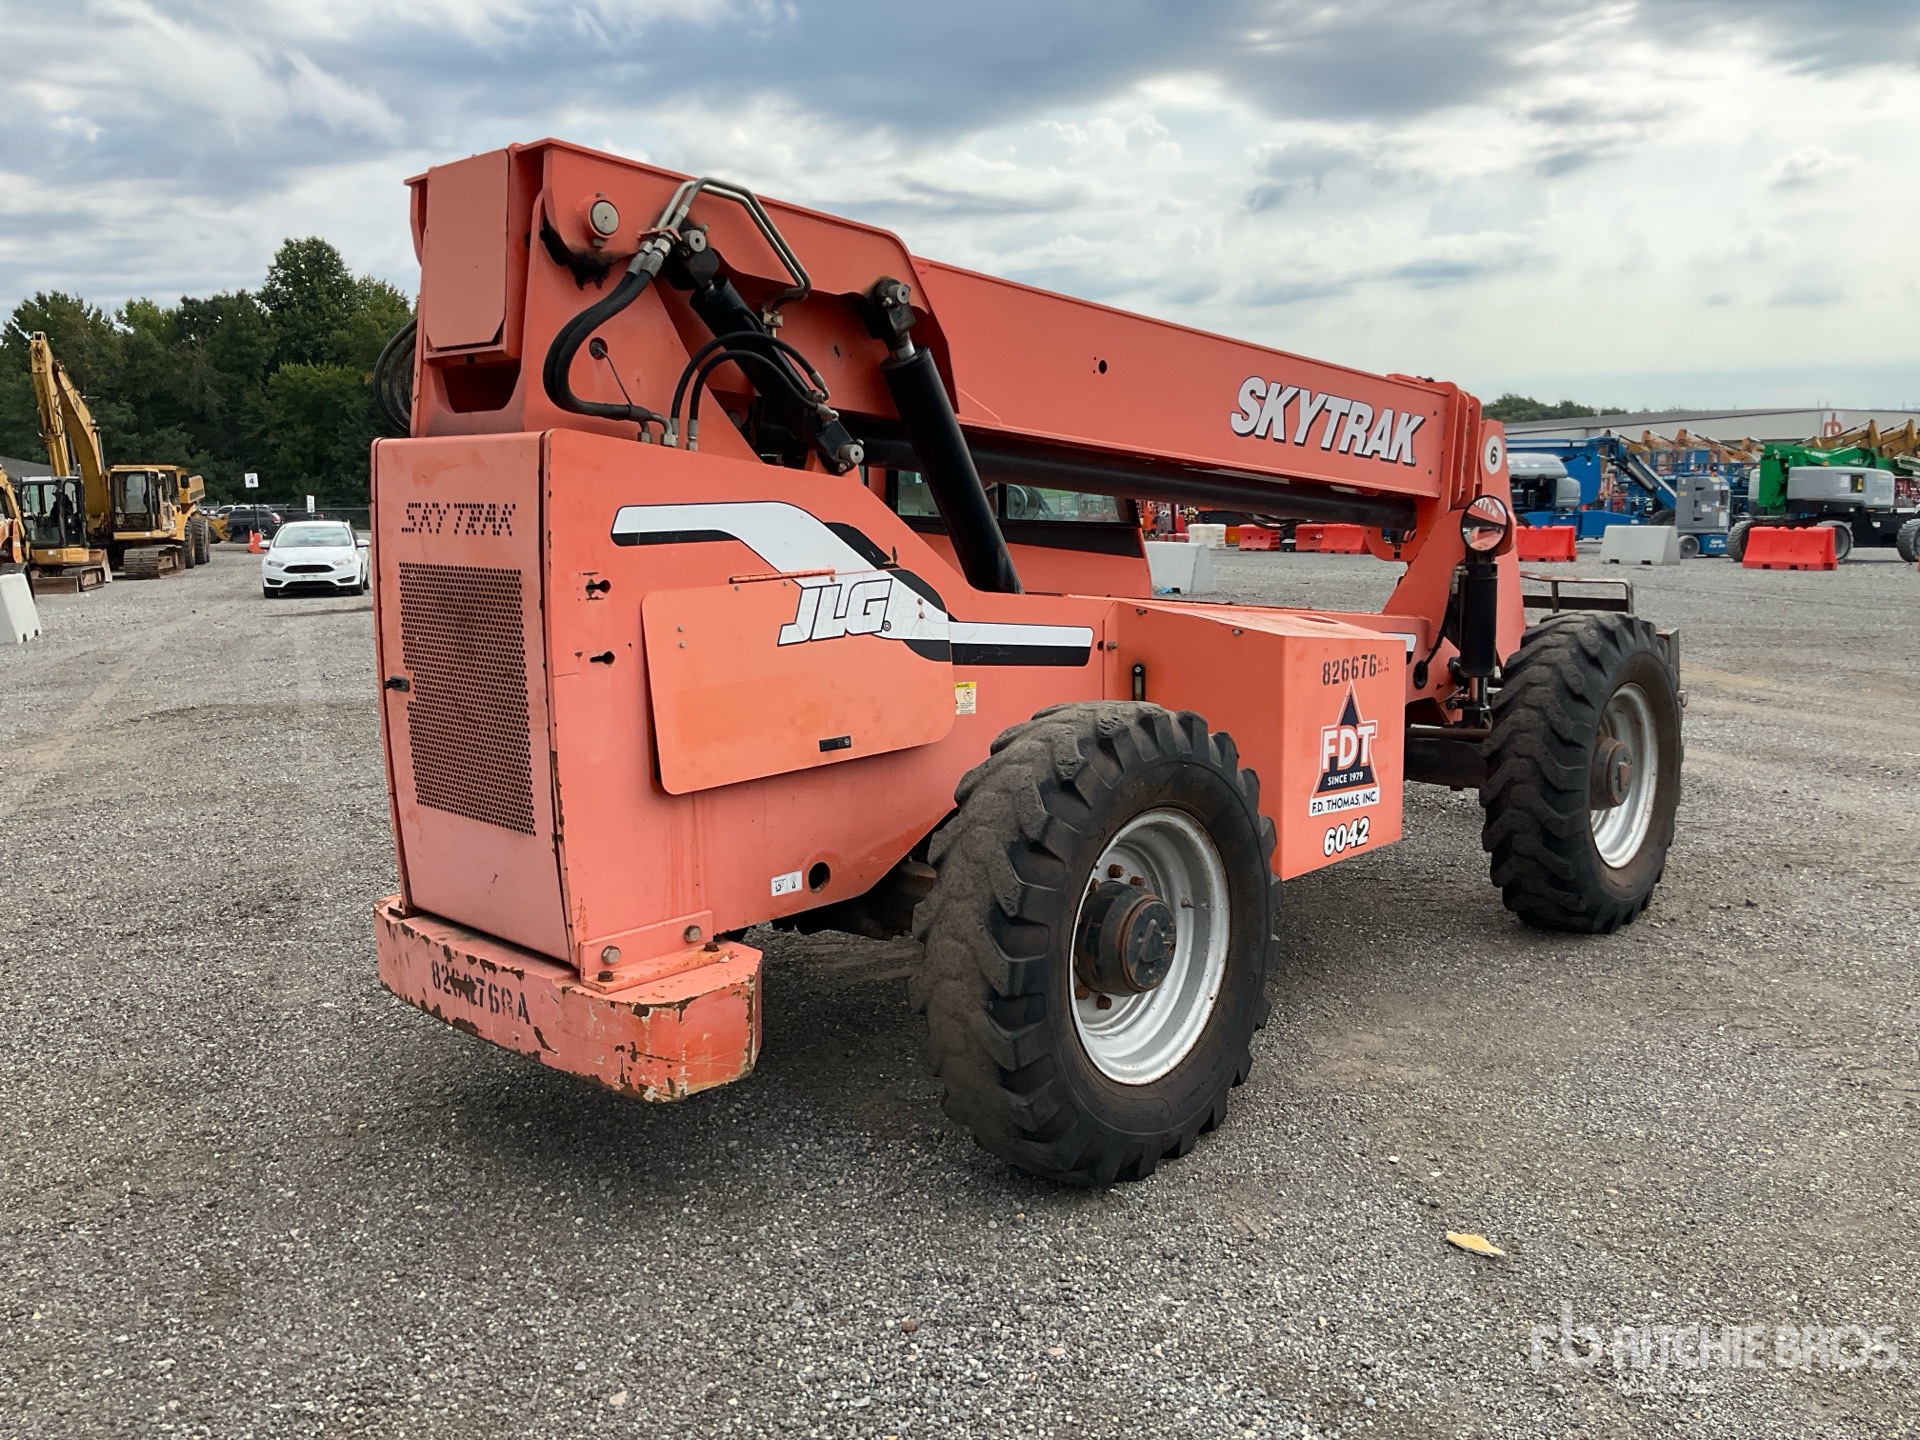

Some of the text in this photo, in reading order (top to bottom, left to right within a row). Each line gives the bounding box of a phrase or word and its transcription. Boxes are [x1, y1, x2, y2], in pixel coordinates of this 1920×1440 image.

[1230, 376, 1425, 465] SKYTRAK
[1490, 445, 1498, 465] 6
[1322, 725, 1375, 771] FDT
[1328, 770, 1364, 786] SINCE 1979
[1312, 791, 1377, 814] F.D. THOMAS, INC.
[1323, 815, 1370, 857] 6042
